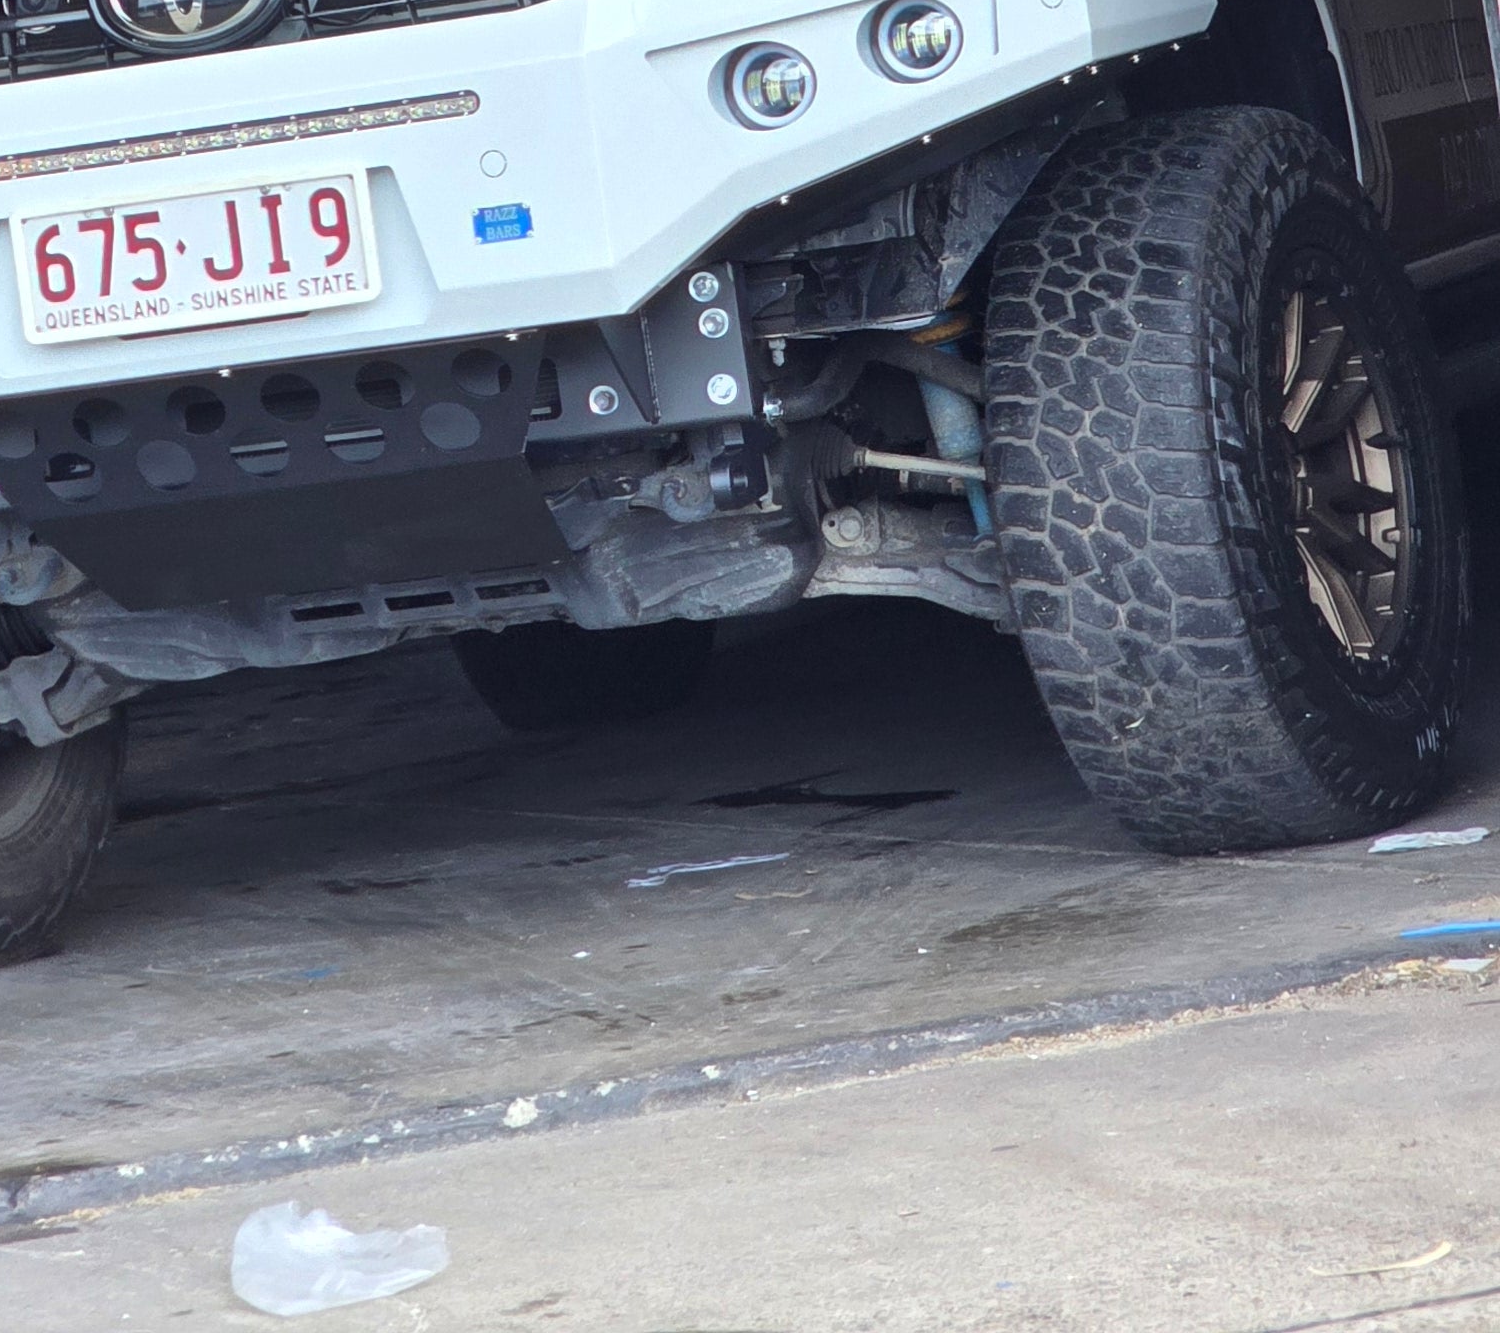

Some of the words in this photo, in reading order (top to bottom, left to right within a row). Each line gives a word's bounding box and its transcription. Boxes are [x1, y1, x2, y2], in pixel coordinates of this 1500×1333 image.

[483, 206, 518, 223] RAZZ
[485, 223, 522, 241] BARS
[45, 297, 171, 331] QUEENSLAND
[191, 282, 288, 311] SUNSHINE
[299, 272, 357, 297] STATE
